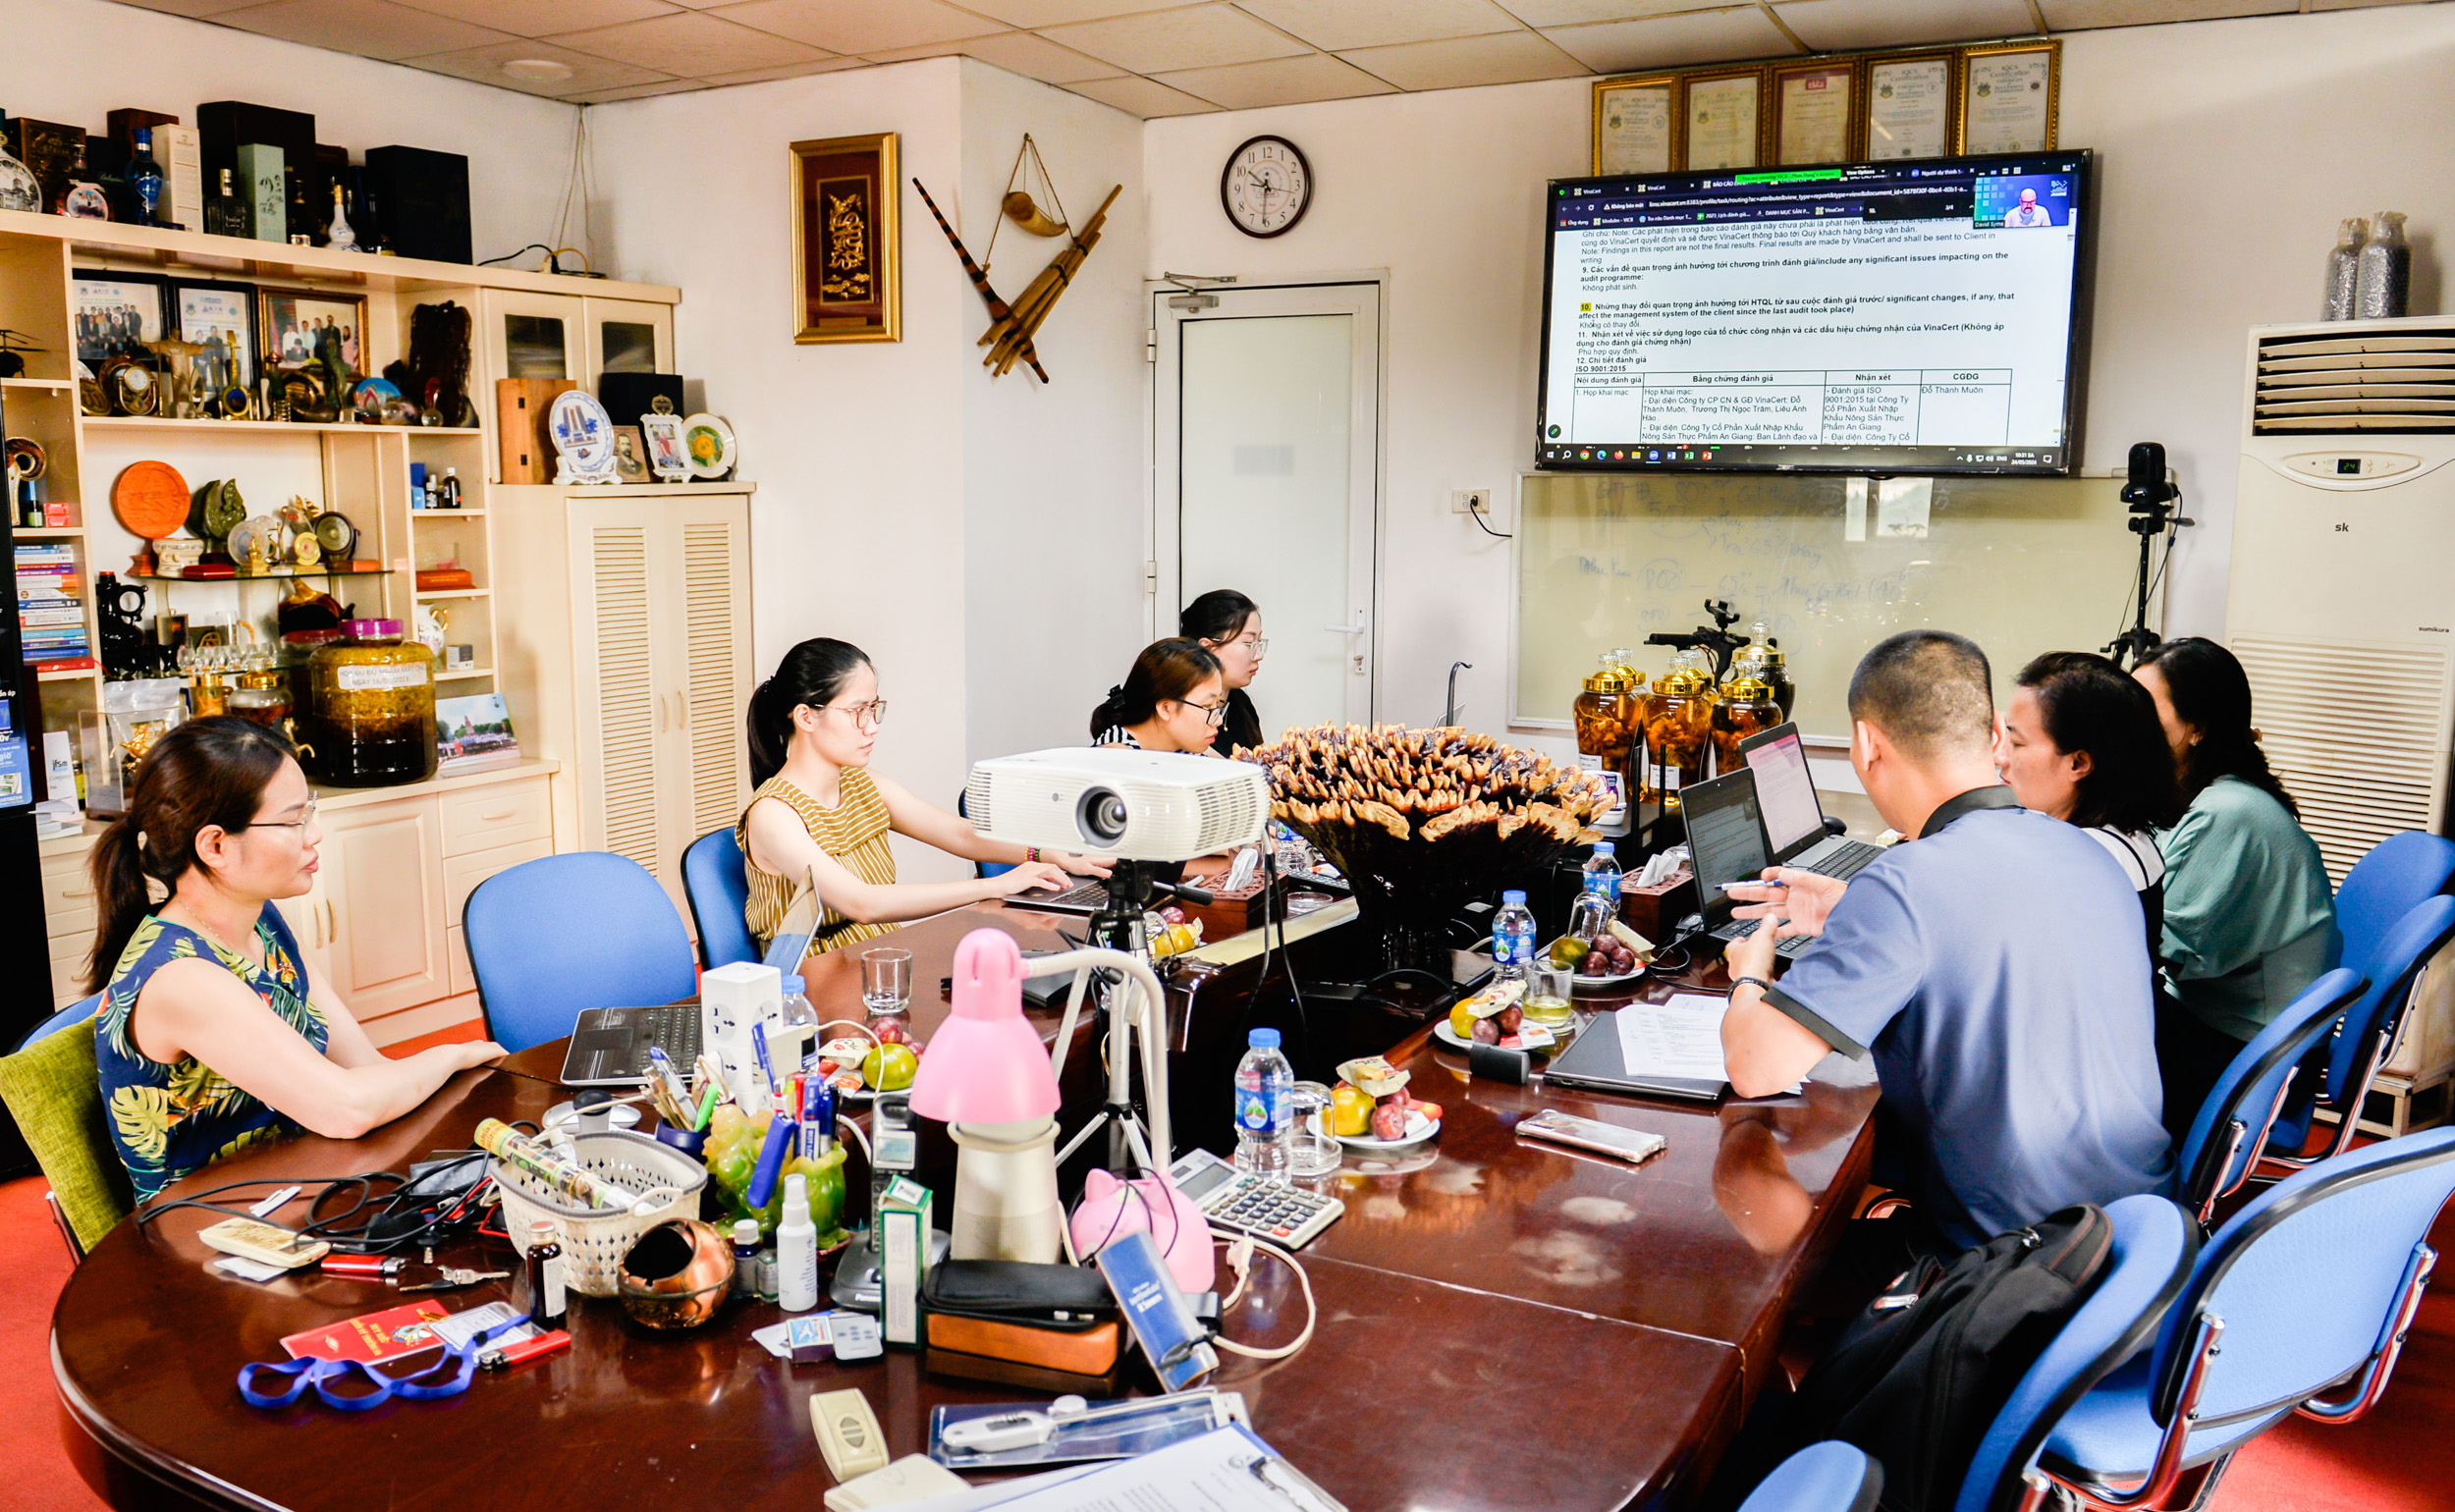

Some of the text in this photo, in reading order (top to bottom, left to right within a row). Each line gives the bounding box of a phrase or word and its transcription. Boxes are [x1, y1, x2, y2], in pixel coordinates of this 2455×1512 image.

[1248, 152, 1255, 163] 11
[1263, 147, 1272, 158] 12
[1237, 166, 1246, 177] 10
[1291, 162, 1297, 173] 2
[1235, 184, 1241, 194] 9
[1295, 180, 1300, 191] 3
[1239, 201, 1245, 212] 8
[1289, 198, 1296, 209] 4
[1249, 214, 1255, 224] 7
[1280, 211, 1286, 223] 5
[1605, 264, 1619, 272] vấn
[1620, 263, 1630, 271] đề
[1688, 261, 1715, 270] hưởng
[1802, 256, 1847, 266] giá/include
[1864, 255, 1908, 264] significant
[1938, 253, 1980, 262] impacting
[1599, 274, 1643, 282] programme:
[1638, 300, 1651, 308] đổi
[1709, 298, 1736, 308] hưởng
[1801, 296, 1821, 305] cuộc
[1844, 295, 1857, 305] giá
[1858, 294, 1885, 303] trước/
[1886, 294, 1929, 303] significant
[1930, 294, 1968, 302] changes,
[1612, 311, 1660, 319] management
[1829, 305, 1854, 314] place)
[1591, 330, 1610, 338] Nhận
[1625, 328, 1633, 336] về
[1635, 329, 1650, 338] việc
[1664, 329, 1683, 337] dụng
[1684, 328, 1701, 337] logo
[1703, 327, 1717, 335] của
[1718, 326, 1726, 335] tổ
[1750, 327, 1769, 335] công
[1770, 326, 1790, 335] nhận
[1819, 324, 1834, 333] dấu
[1836, 325, 1853, 334] hiệu
[1855, 324, 1881, 333] chứng
[1883, 324, 1904, 333] nhận
[1906, 323, 1921, 331] của
[1960, 322, 1991, 331] (Không
[1993, 322, 2004, 331] áp
[1630, 338, 1642, 347] giá
[1643, 337, 1668, 346] chứng
[1669, 337, 1691, 346] nhận)
[1635, 356, 1647, 364] giá
[1589, 376, 1609, 384] dung
[1629, 375, 1641, 384] giá
[1692, 373, 1712, 383] Bằng
[1713, 374, 1738, 383] chứng
[1761, 373, 1773, 383] giá
[1855, 373, 1876, 382] Nhận
[2343, 462, 2356, 470] 24
[2335, 522, 2349, 532] sk
